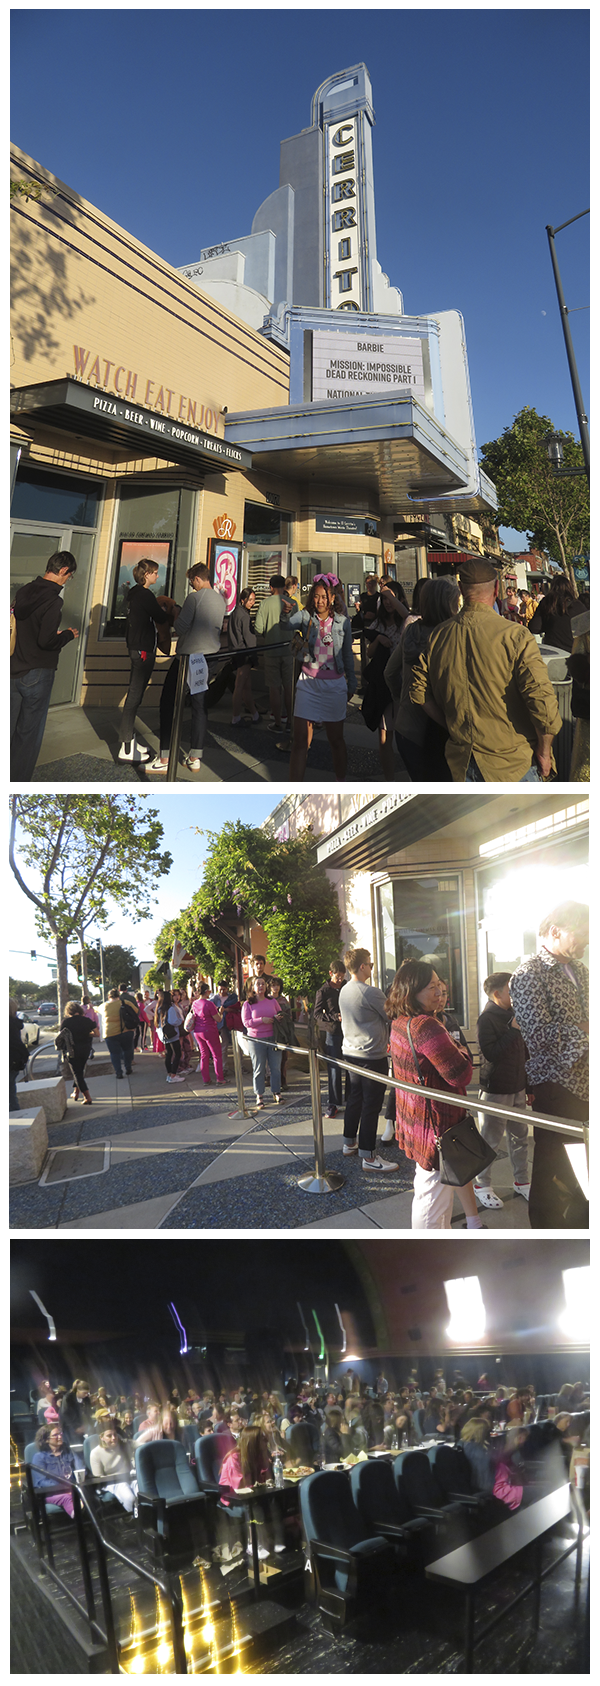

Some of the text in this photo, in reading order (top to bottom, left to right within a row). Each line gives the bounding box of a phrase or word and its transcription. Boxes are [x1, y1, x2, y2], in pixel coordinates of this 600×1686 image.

[357, 342, 385, 353] BARBIE
[329, 360, 412, 374] MISSION: IMPOSSIBLE
[326, 369, 346, 380] DEAD
[348, 371, 392, 383] RECKONING
[393, 374, 412, 384] PART
[73, 345, 220, 433] WATCH EAT ENJOY
[93, 397, 243, 461] PIZZA BEER WINE POPCORN TREATS FLICKS
[305, 1559, 312, 1573] A
